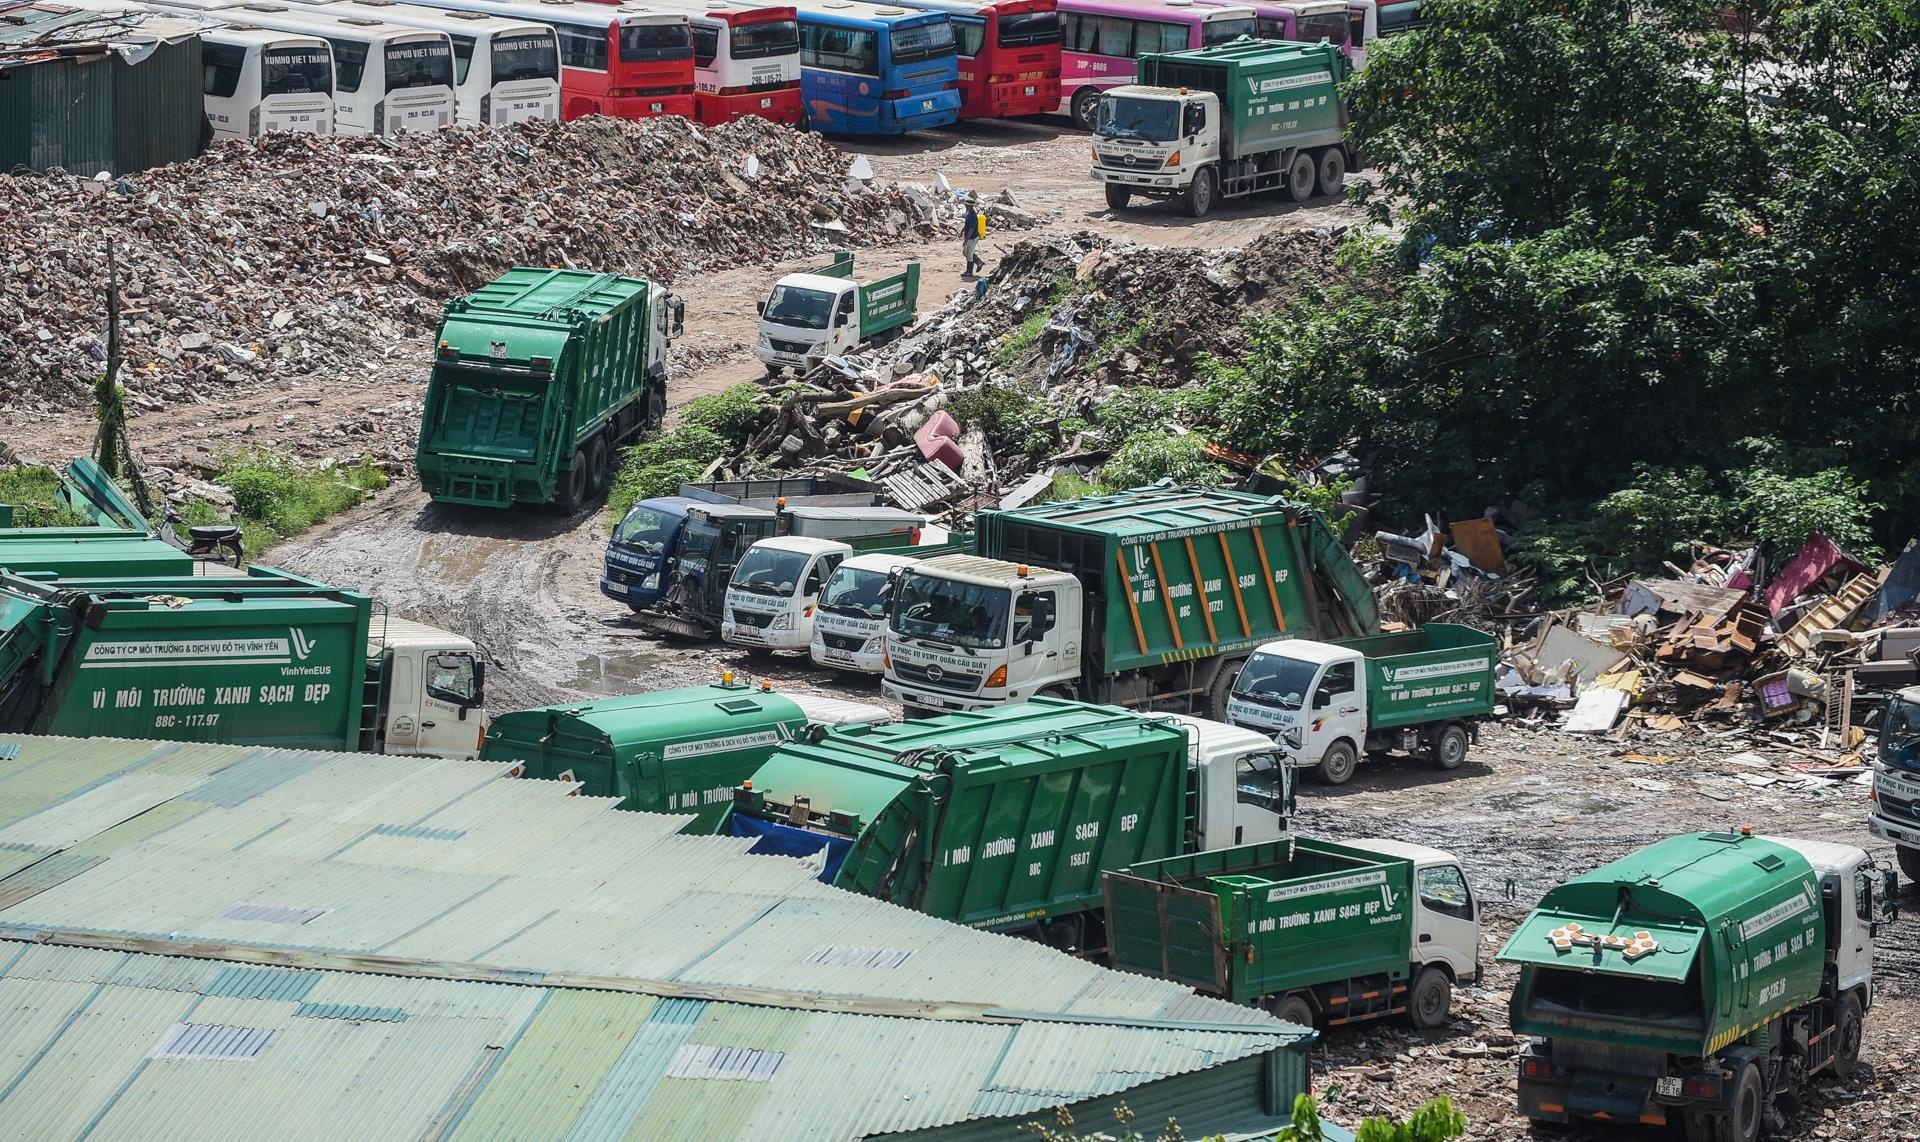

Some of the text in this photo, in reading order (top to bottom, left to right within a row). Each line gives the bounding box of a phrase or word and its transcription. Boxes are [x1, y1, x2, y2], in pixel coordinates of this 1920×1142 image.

[1121, 534, 1138, 546] CÔNG
[1139, 534, 1146, 543] TY
[1146, 534, 1155, 542] CP
[1142, 587, 1156, 603] MÔI
[1167, 582, 1193, 598] TRƯỜNG
[1204, 579, 1222, 593] XANH
[1238, 574, 1256, 589] SẠCH
[1275, 569, 1288, 583] ĐẸP
[1143, 580, 1156, 589] EUS
[94, 640, 279, 655] CÔNG TY CP MÔI TRƯỜNG & DỊCH VỤ ĐÔ THỊ VĨNH YÊN
[889, 645, 988, 670] XE PHỤC VỤ VSMT QUẬN CẦU GIẤY
[280, 665, 331, 676] VinhYenEUS
[92, 683, 331, 709] VÌ MÔI TRƯỜNG XANH SẠCH ĐẸP
[155, 715, 176, 728] 88C
[185, 714, 219, 727] 117.97
[668, 746, 682, 755] CÔNG
[1882, 777, 1897, 789] PHỤC
[669, 784, 735, 810] VÌ MÔI TRƯỜNG
[952, 845, 971, 865] MÔI
[1030, 829, 1055, 849] XANH
[1075, 821, 1099, 841] SẠCH
[1121, 813, 1138, 832] ĐẸP
[1259, 916, 1275, 932] MÔI
[1279, 911, 1310, 929] TRƯỜNG
[1313, 908, 1336, 924] XANH
[1339, 904, 1361, 919] SẠCH
[1364, 901, 1380, 915] ĐẸP
